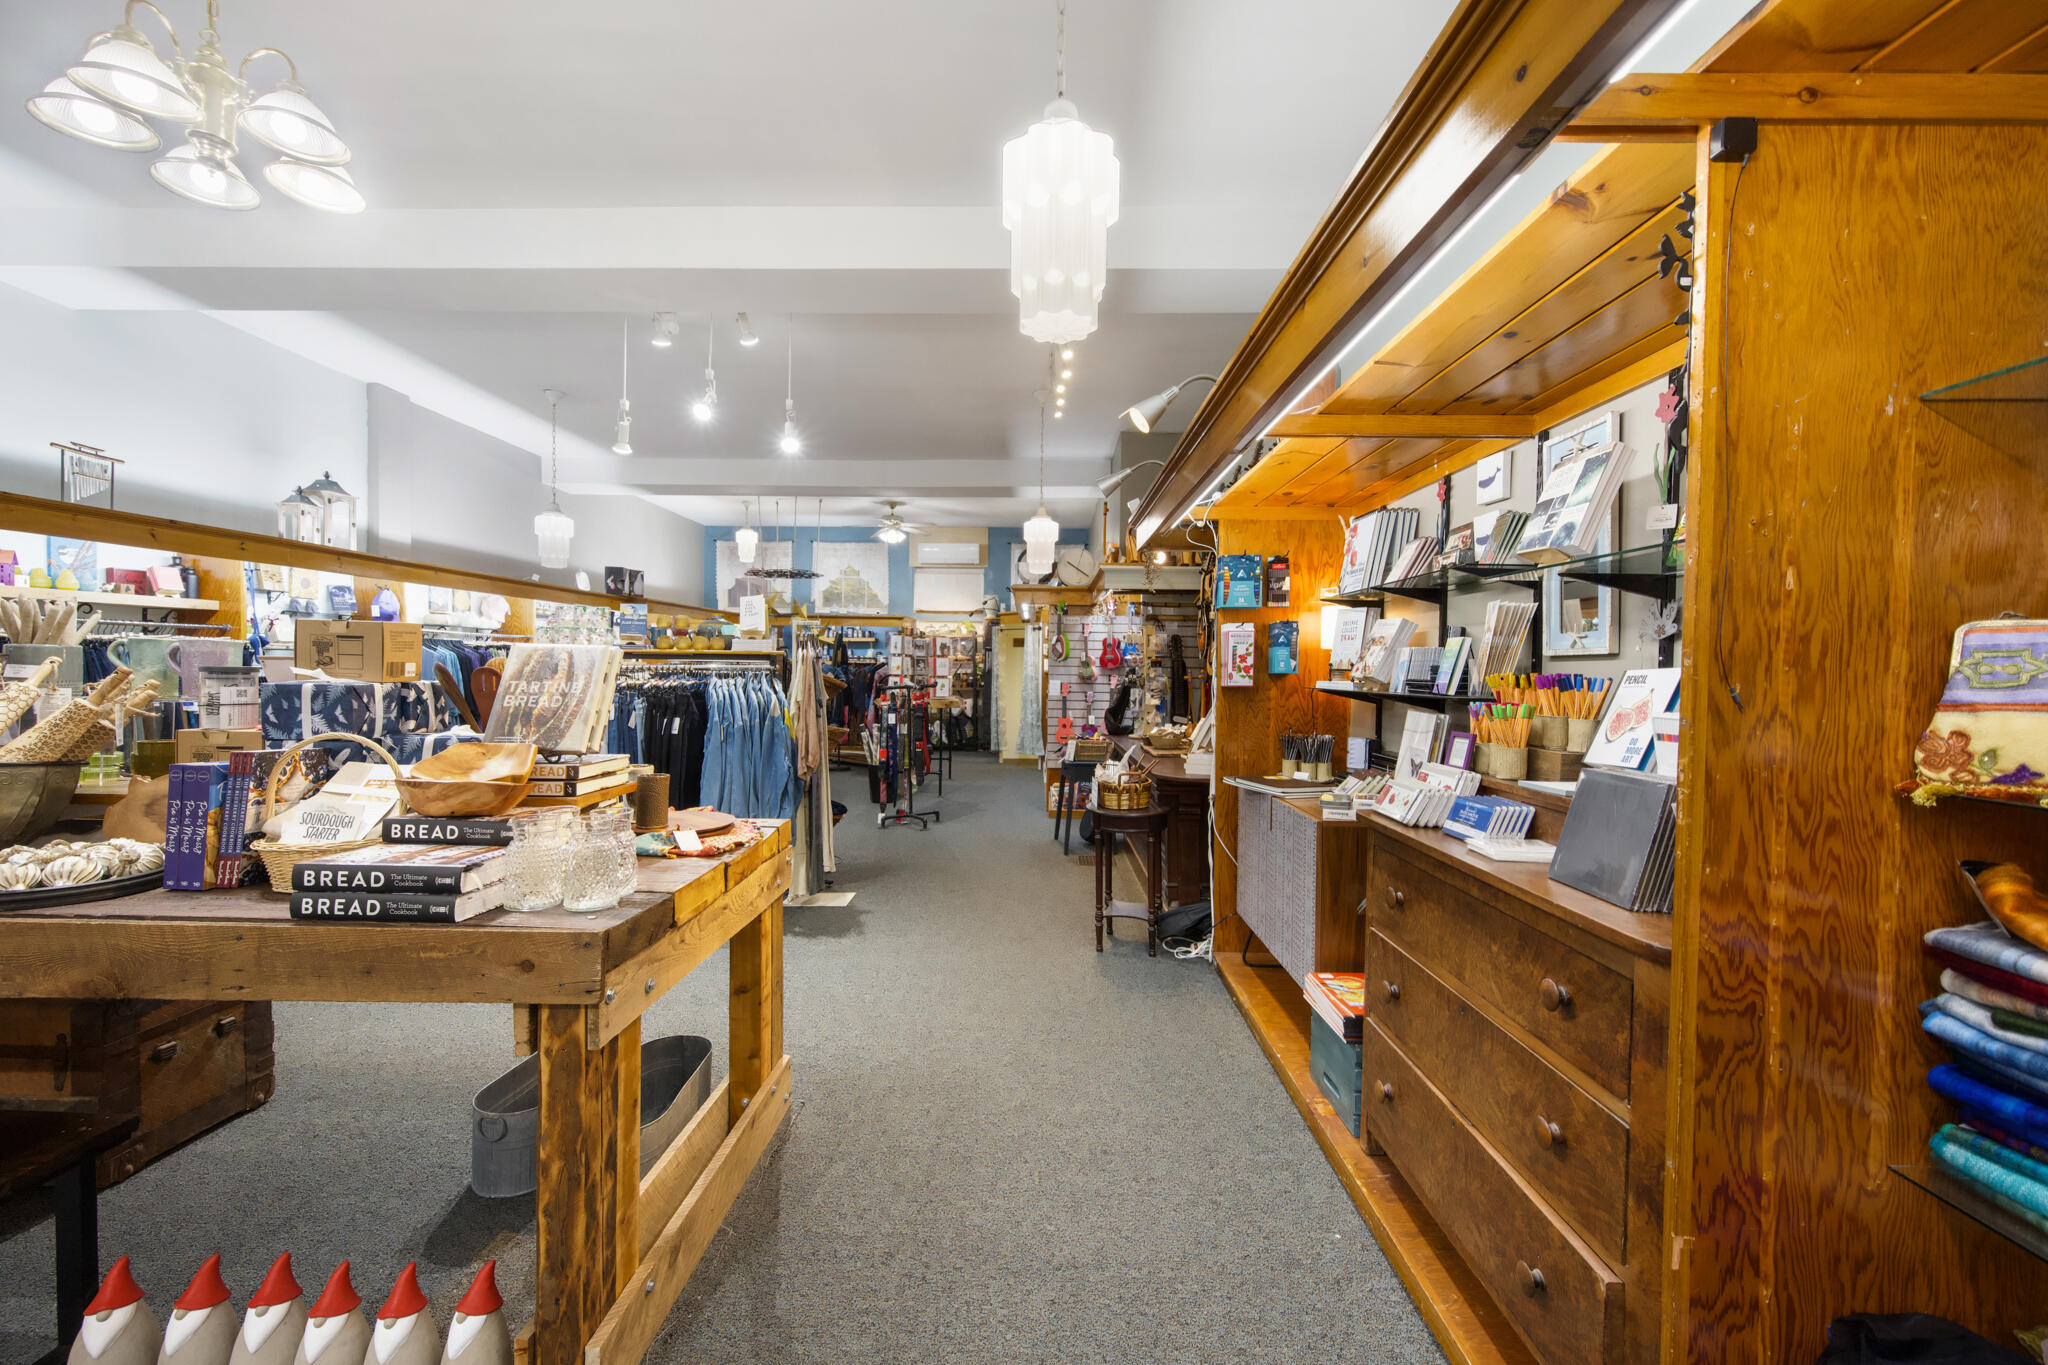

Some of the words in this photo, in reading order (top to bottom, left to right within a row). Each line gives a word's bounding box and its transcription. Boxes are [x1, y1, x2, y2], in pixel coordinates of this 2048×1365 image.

[508, 680, 583, 693] TARTINE
[1624, 674, 1648, 685] PENCIL
[503, 695, 563, 707] BREAD
[531, 766, 565, 777] READ
[537, 783, 563, 794] EAD
[169, 800, 181, 815] Pie
[183, 800, 195, 816] Pie
[196, 801, 208, 817] Pie
[299, 811, 356, 829] SOURDOUGH
[167, 825, 180, 853] Messy
[181, 826, 194, 853] Messy
[236, 822, 244, 853] COOKBOOK
[302, 826, 340, 840] STARTER
[391, 823, 459, 840] BREAD
[193, 826, 207, 854] Messy
[303, 870, 385, 888] BREAD
[403, 873, 428, 881] Ultimate
[301, 898, 381, 916] BREAD
[386, 901, 397, 909] The
[398, 901, 423, 909] Ultimate
